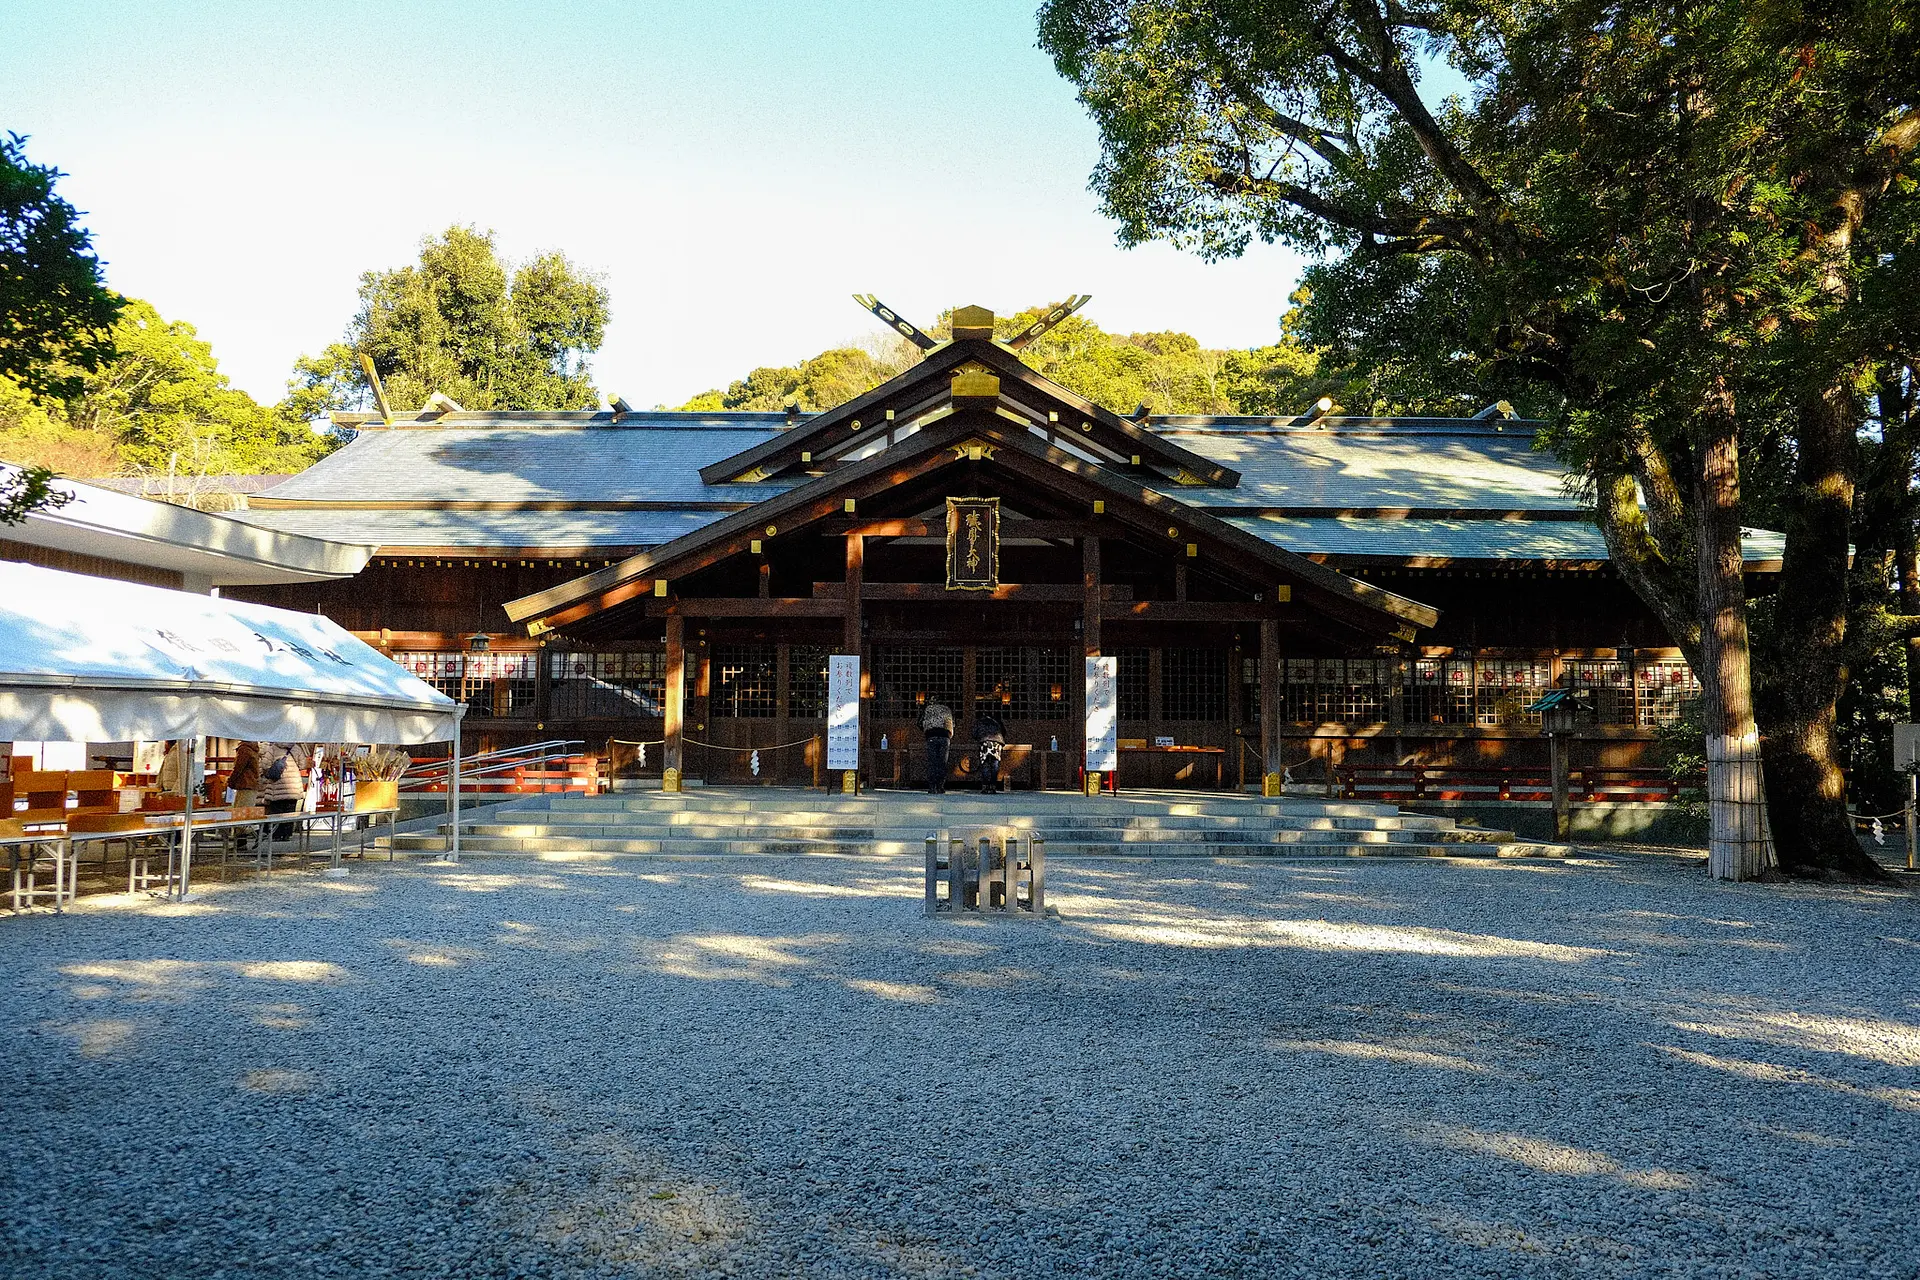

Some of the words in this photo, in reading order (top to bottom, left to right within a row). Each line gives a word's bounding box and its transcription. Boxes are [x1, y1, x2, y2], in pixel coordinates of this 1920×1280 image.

[835, 661, 844, 719] お参りください
[1093, 663, 1101, 713] お参りくださ
